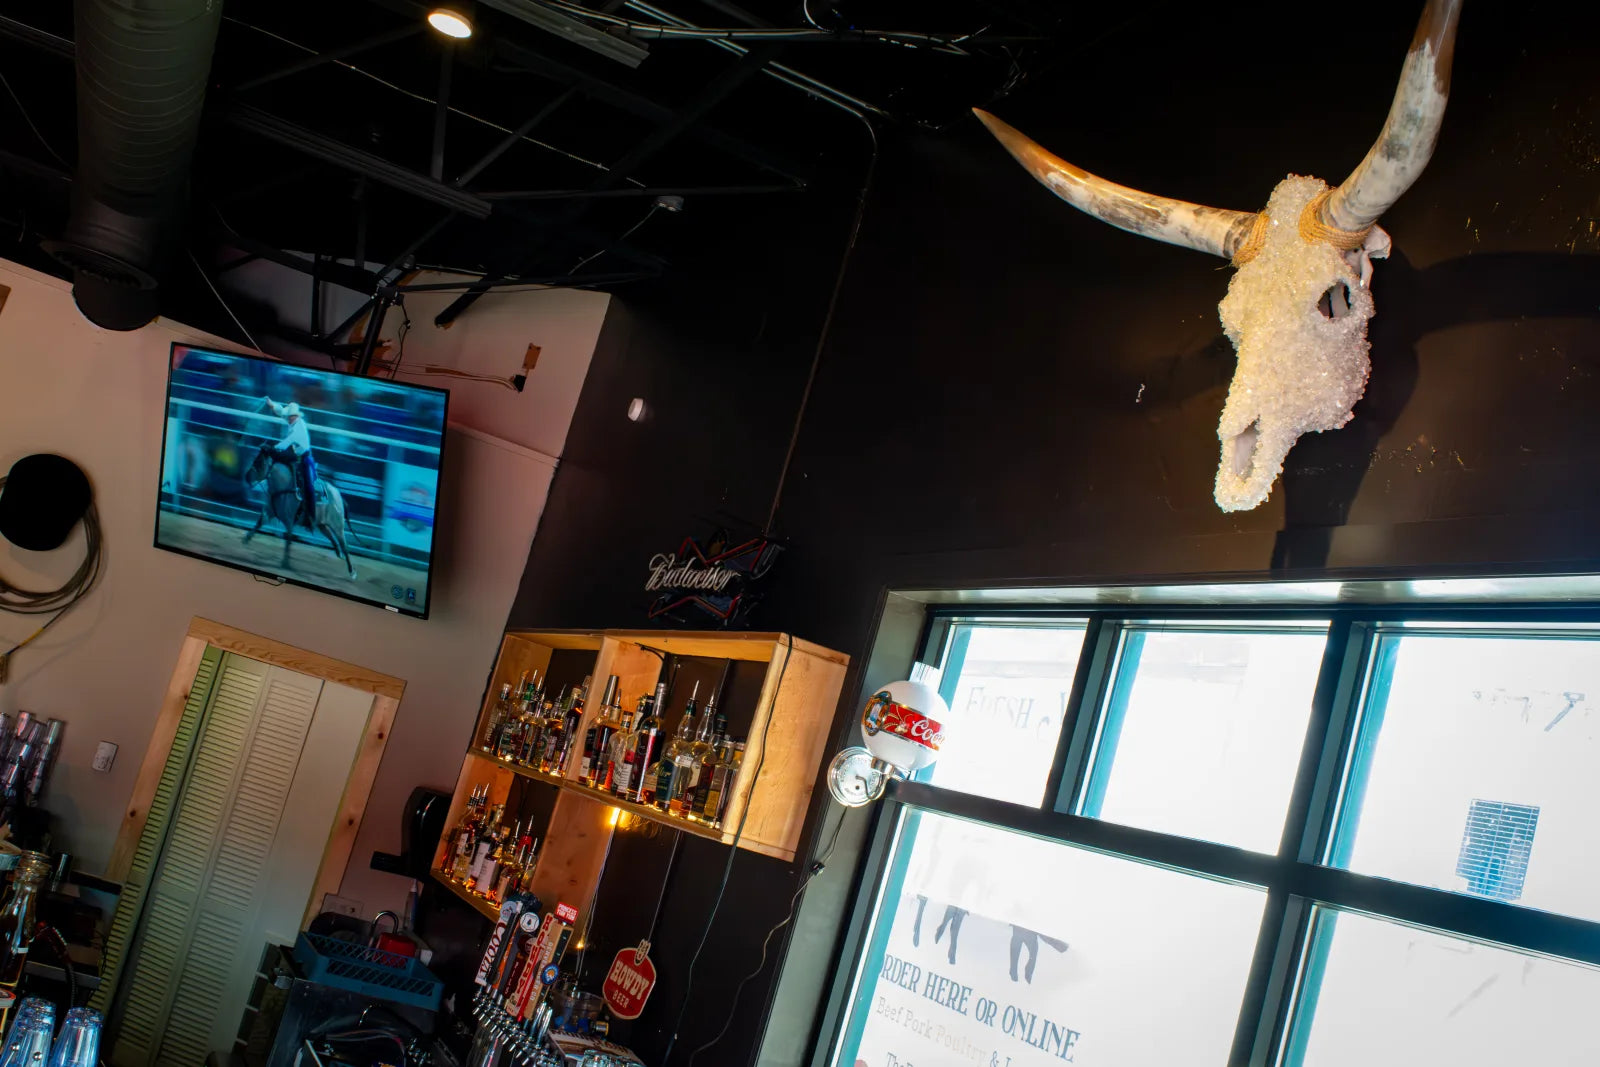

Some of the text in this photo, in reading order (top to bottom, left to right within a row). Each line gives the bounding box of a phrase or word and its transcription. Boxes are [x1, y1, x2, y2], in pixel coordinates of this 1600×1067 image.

[645, 552, 742, 592] Budweiser
[610, 960, 649, 1000] HOWDY
[612, 990, 629, 1008] BEER
[876, 997, 904, 1022] Beef
[904, 1011, 936, 1040] Pork
[935, 1025, 987, 1065] Poultry
[922, 972, 974, 1016] HERE
[975, 997, 997, 1028] OR
[1002, 1005, 1081, 1063] ONLINE
